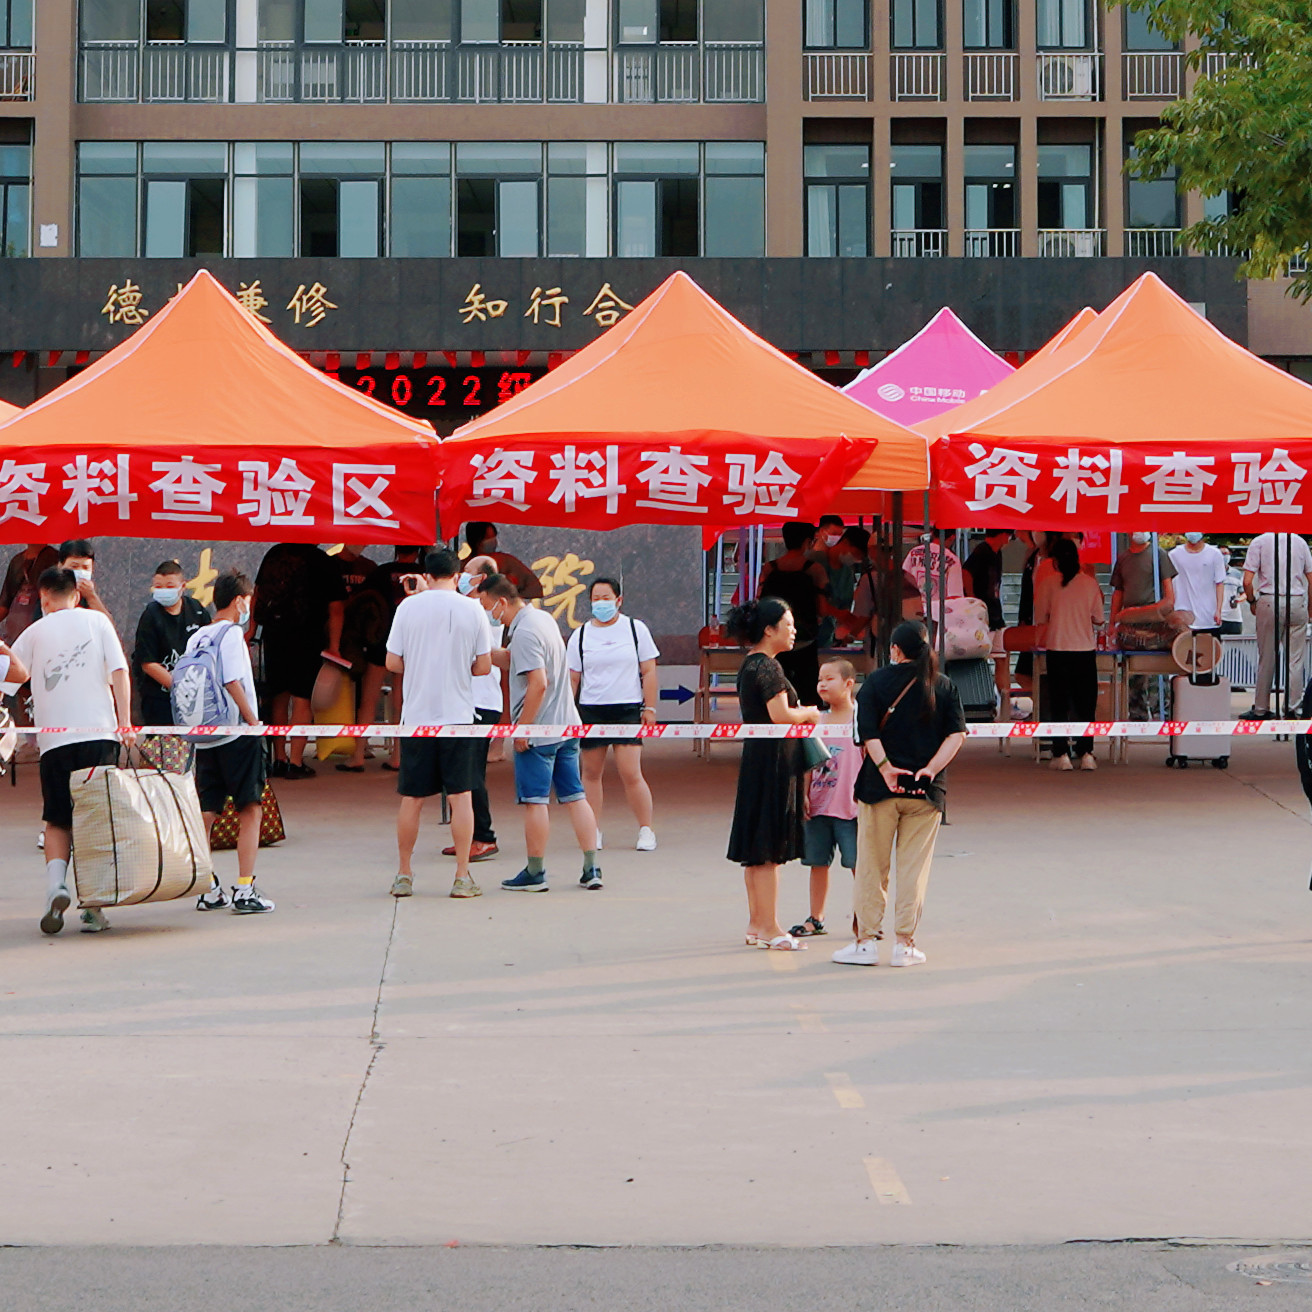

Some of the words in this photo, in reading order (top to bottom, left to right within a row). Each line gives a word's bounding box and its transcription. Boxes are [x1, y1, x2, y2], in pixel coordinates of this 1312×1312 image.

[101, 278, 339, 329] 德兼修
[909, 386, 966, 398] 中国移动
[464, 444, 802, 517] 资料查验
